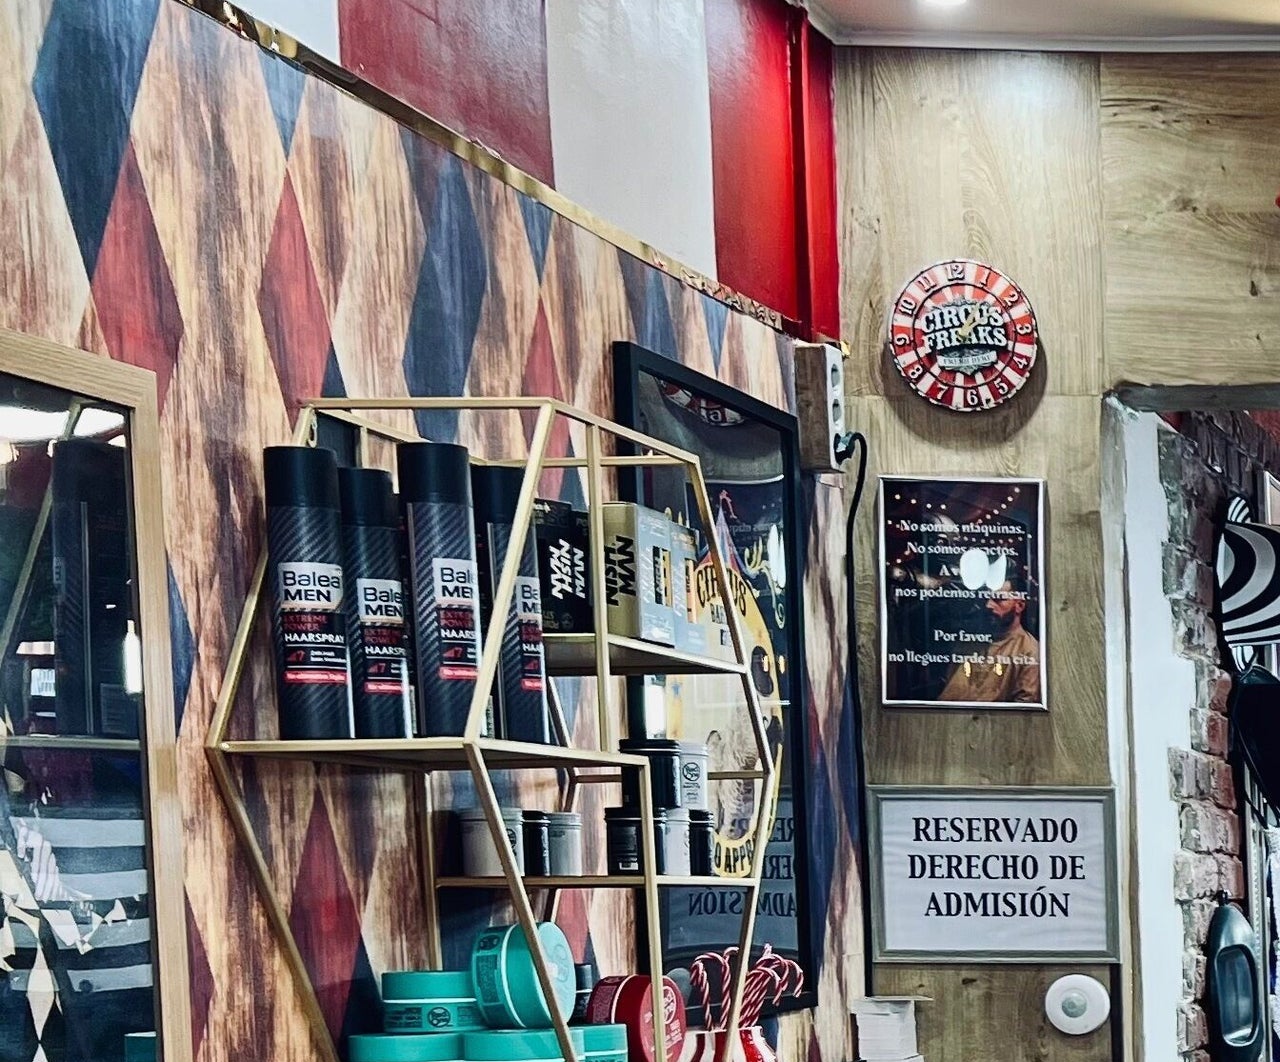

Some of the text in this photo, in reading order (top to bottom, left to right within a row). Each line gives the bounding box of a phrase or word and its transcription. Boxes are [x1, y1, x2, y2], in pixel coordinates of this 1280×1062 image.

[946, 264, 965, 281] 12
[979, 270, 991, 288] 1
[917, 274, 937, 292] 11
[899, 298, 917, 315] 10
[1003, 292, 1019, 307] 2
[923, 304, 1005, 333] CIRCUS
[1016, 323, 1032, 335] 3
[895, 333, 910, 346] 9
[923, 326, 1008, 354] FREAKS
[1013, 356, 1029, 369] 4
[909, 365, 924, 379] 8
[937, 384, 949, 400] 7
[995, 378, 1009, 394] 5
[966, 389, 979, 406] 6
[900, 520, 919, 532] No
[919, 522, 960, 533] somos
[906, 541, 925, 554] No
[927, 545, 966, 555] somos
[616, 535, 636, 596] MAN
[283, 571, 341, 588] Balea
[441, 568, 473, 583] Bal
[284, 589, 331, 602] MEN
[364, 587, 401, 602] Bale
[442, 586, 473, 598] ME
[697, 565, 746, 617] CIRUS
[895, 588, 917, 598] nos
[919, 587, 976, 600] podemos
[285, 633, 344, 643] HAARSPRAY
[934, 630, 956, 641] Por
[889, 653, 905, 662] no
[905, 649, 950, 666] llegues
[952, 653, 986, 665] tarde
[987, 655, 996, 664] a
[997, 655, 1011, 665] tu
[912, 817, 1078, 843] RESERVADO
[907, 854, 1086, 880] DERECHO DE
[924, 886, 1070, 918] ADMISIÓN
